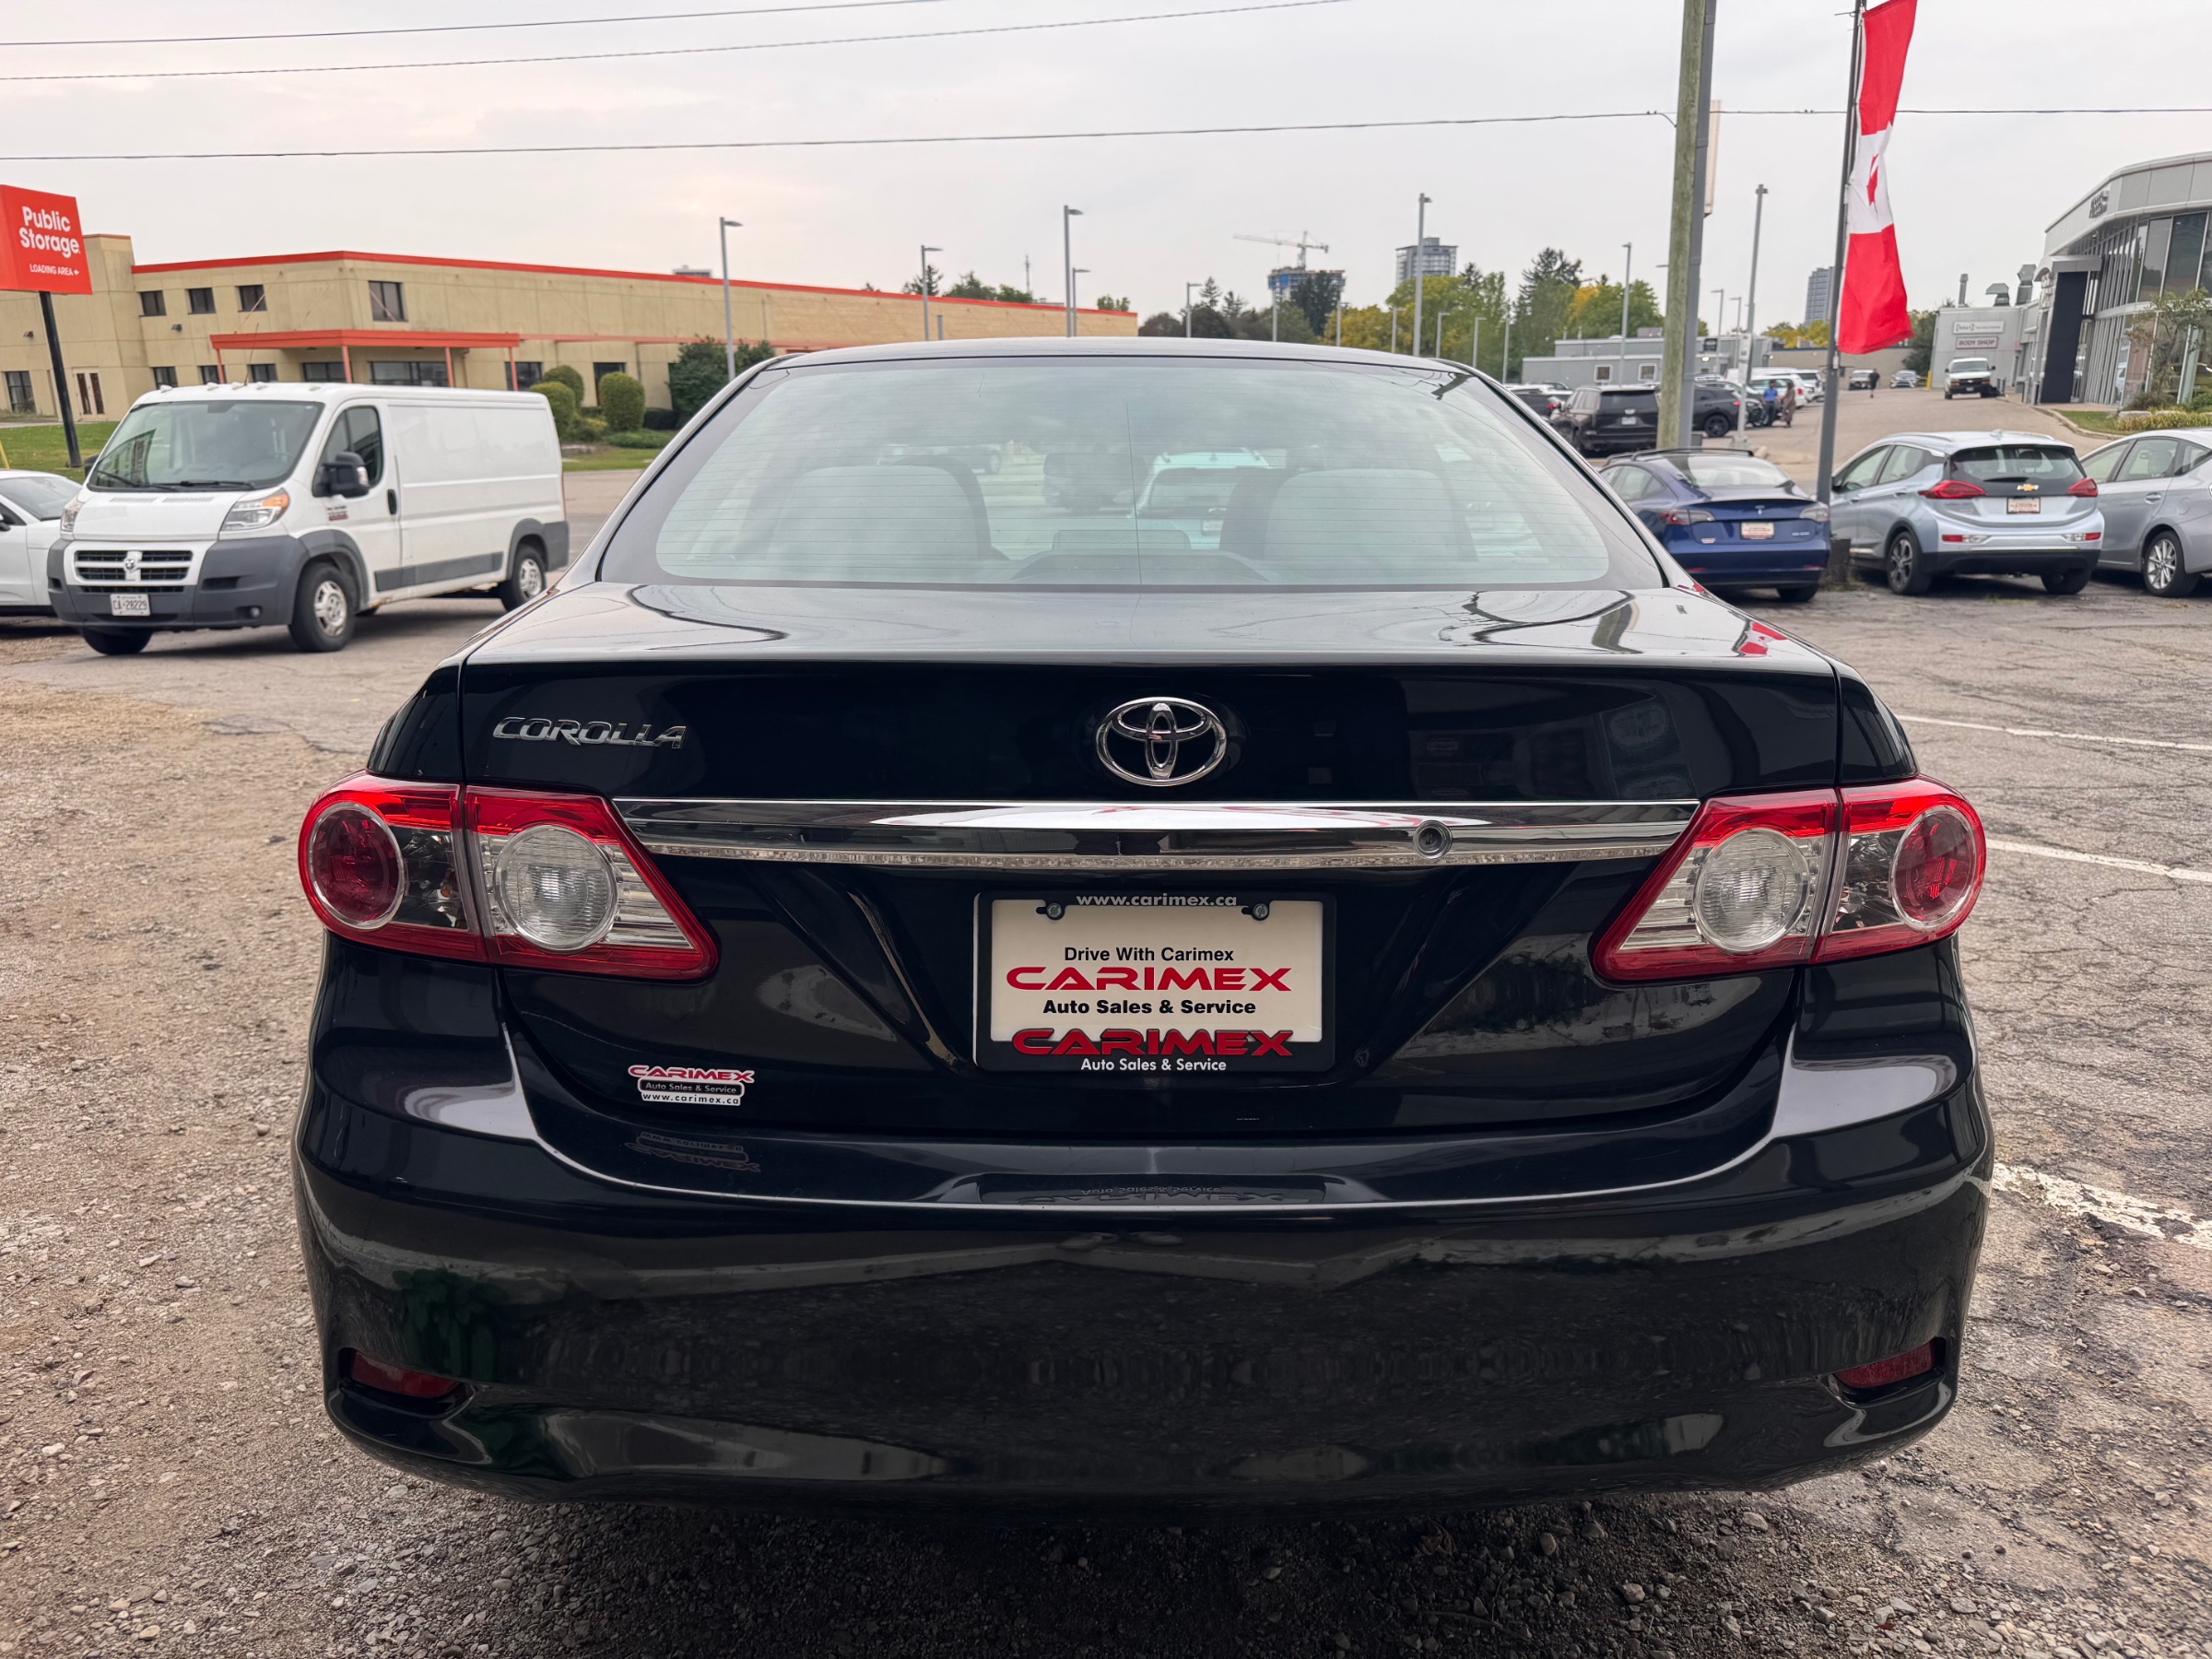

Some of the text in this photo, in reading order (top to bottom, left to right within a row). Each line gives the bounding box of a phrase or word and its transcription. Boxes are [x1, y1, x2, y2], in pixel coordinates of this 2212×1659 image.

[22, 206, 71, 232] Public
[18, 227, 79, 258] Storage
[29, 264, 74, 276] LOADING AREA
[492, 716, 687, 749] COROLLA
[1076, 893, 1238, 907] www.carimex.ca
[1065, 947, 1234, 961] Drive With Carimex
[1006, 966, 1292, 992] CARIMEX
[1042, 999, 1256, 1015] Auto Sales & Service
[1012, 1028, 1293, 1056] CARIMEX
[1080, 1058, 1227, 1071] Auto Sales & Service
[629, 1066, 754, 1082] CARIMEX
[645, 1081, 666, 1090] Auto
[668, 1083, 692, 1091] Sales
[704, 1084, 737, 1094] Service
[643, 1093, 739, 1104] www.carimex.ca
